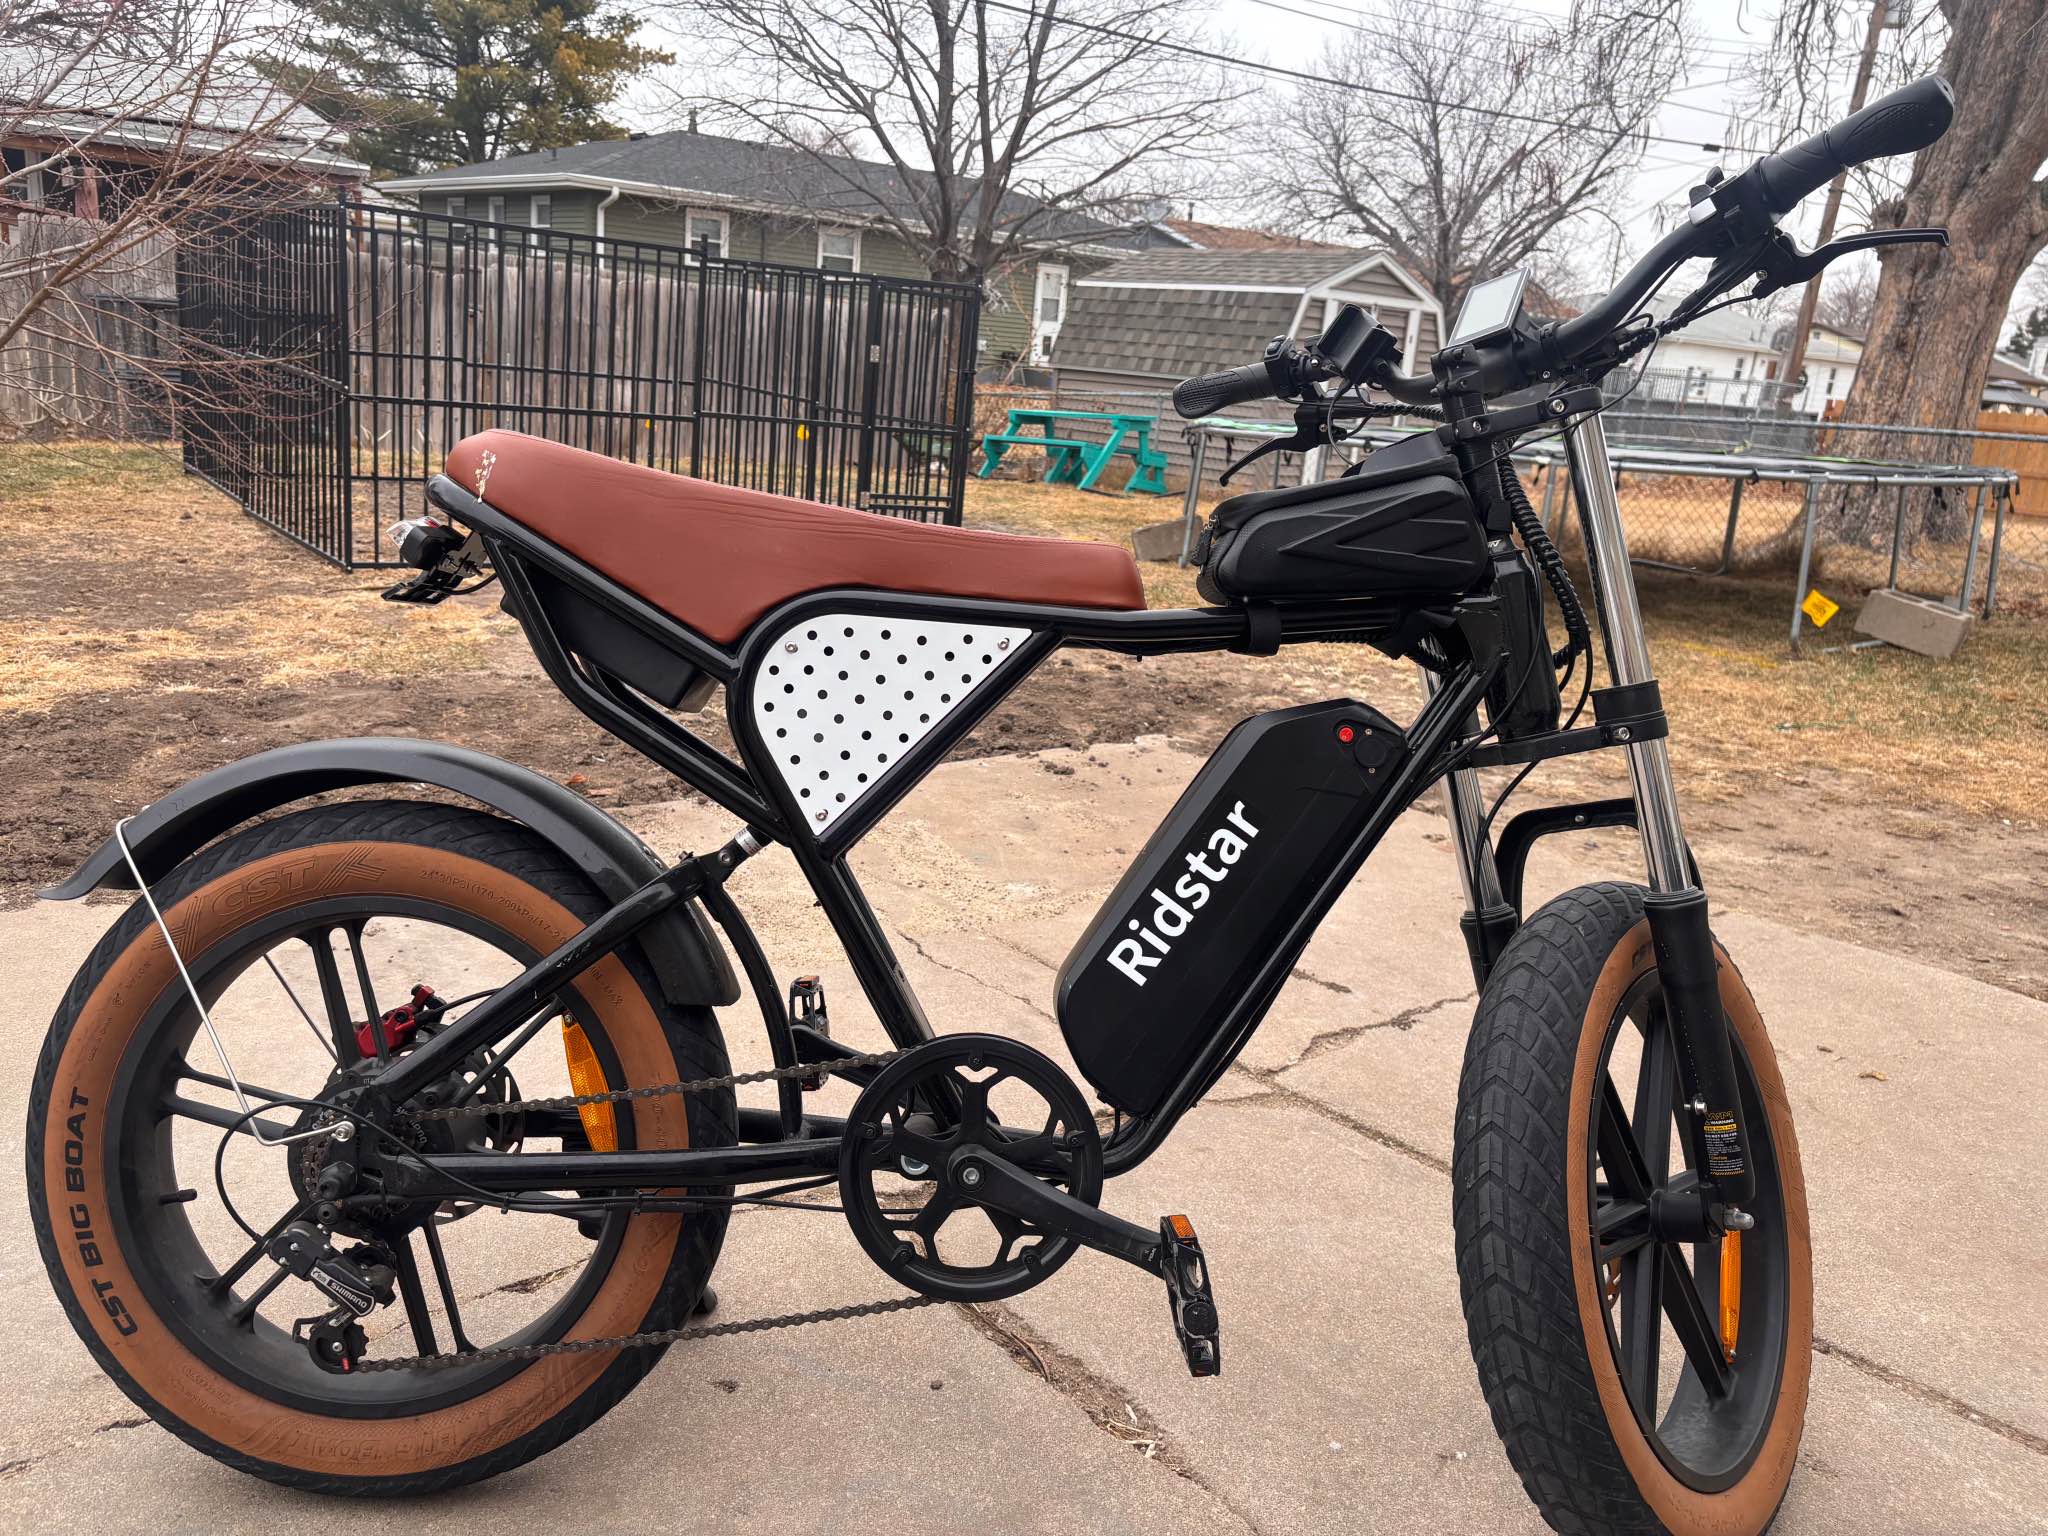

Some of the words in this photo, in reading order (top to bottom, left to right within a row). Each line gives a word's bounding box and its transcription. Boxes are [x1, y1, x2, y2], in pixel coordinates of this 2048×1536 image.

[211, 856, 317, 917] CST
[1106, 800, 1260, 987] Ridstar
[64, 1086, 89, 1193] BOAT
[69, 1203, 104, 1268] BIG
[91, 1278, 138, 1337] CST
[330, 1282, 367, 1308] SHIMANO
